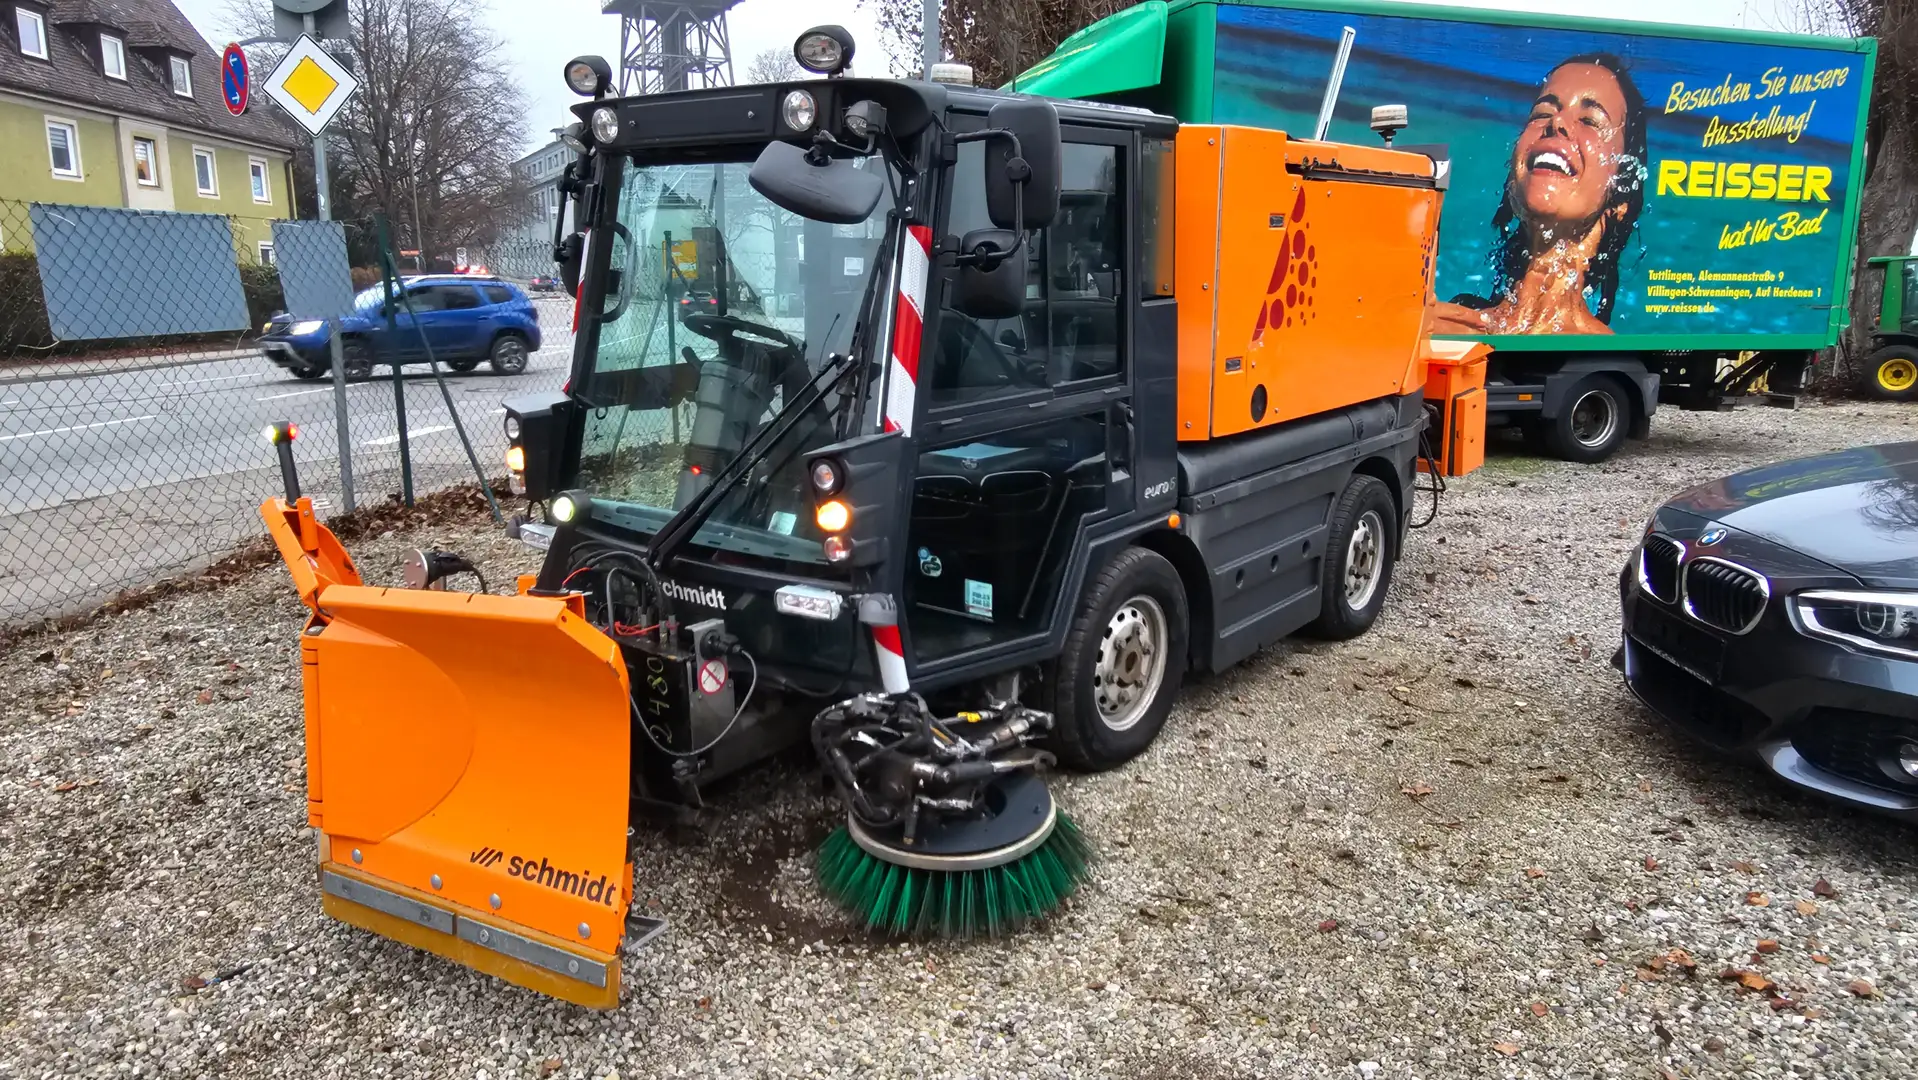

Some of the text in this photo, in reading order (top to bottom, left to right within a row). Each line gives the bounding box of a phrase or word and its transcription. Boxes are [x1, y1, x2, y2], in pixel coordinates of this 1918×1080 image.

[1664, 66, 1850, 115] Besuchen Sie unsere
[1702, 99, 1817, 148] Ausstellung!
[1656, 160, 1832, 202] REISSER
[1718, 208, 1828, 250] hat Ihr Bad
[1647, 285, 1821, 300] Villingen-Schwenningen, Auf Herdenen 1
[1648, 269, 1784, 283] Tuttlingen, Alemannenstraße 9
[1645, 301, 1715, 313] www.reisser.de
[659, 579, 727, 611] chmidt
[507, 855, 616, 907] schmidt
